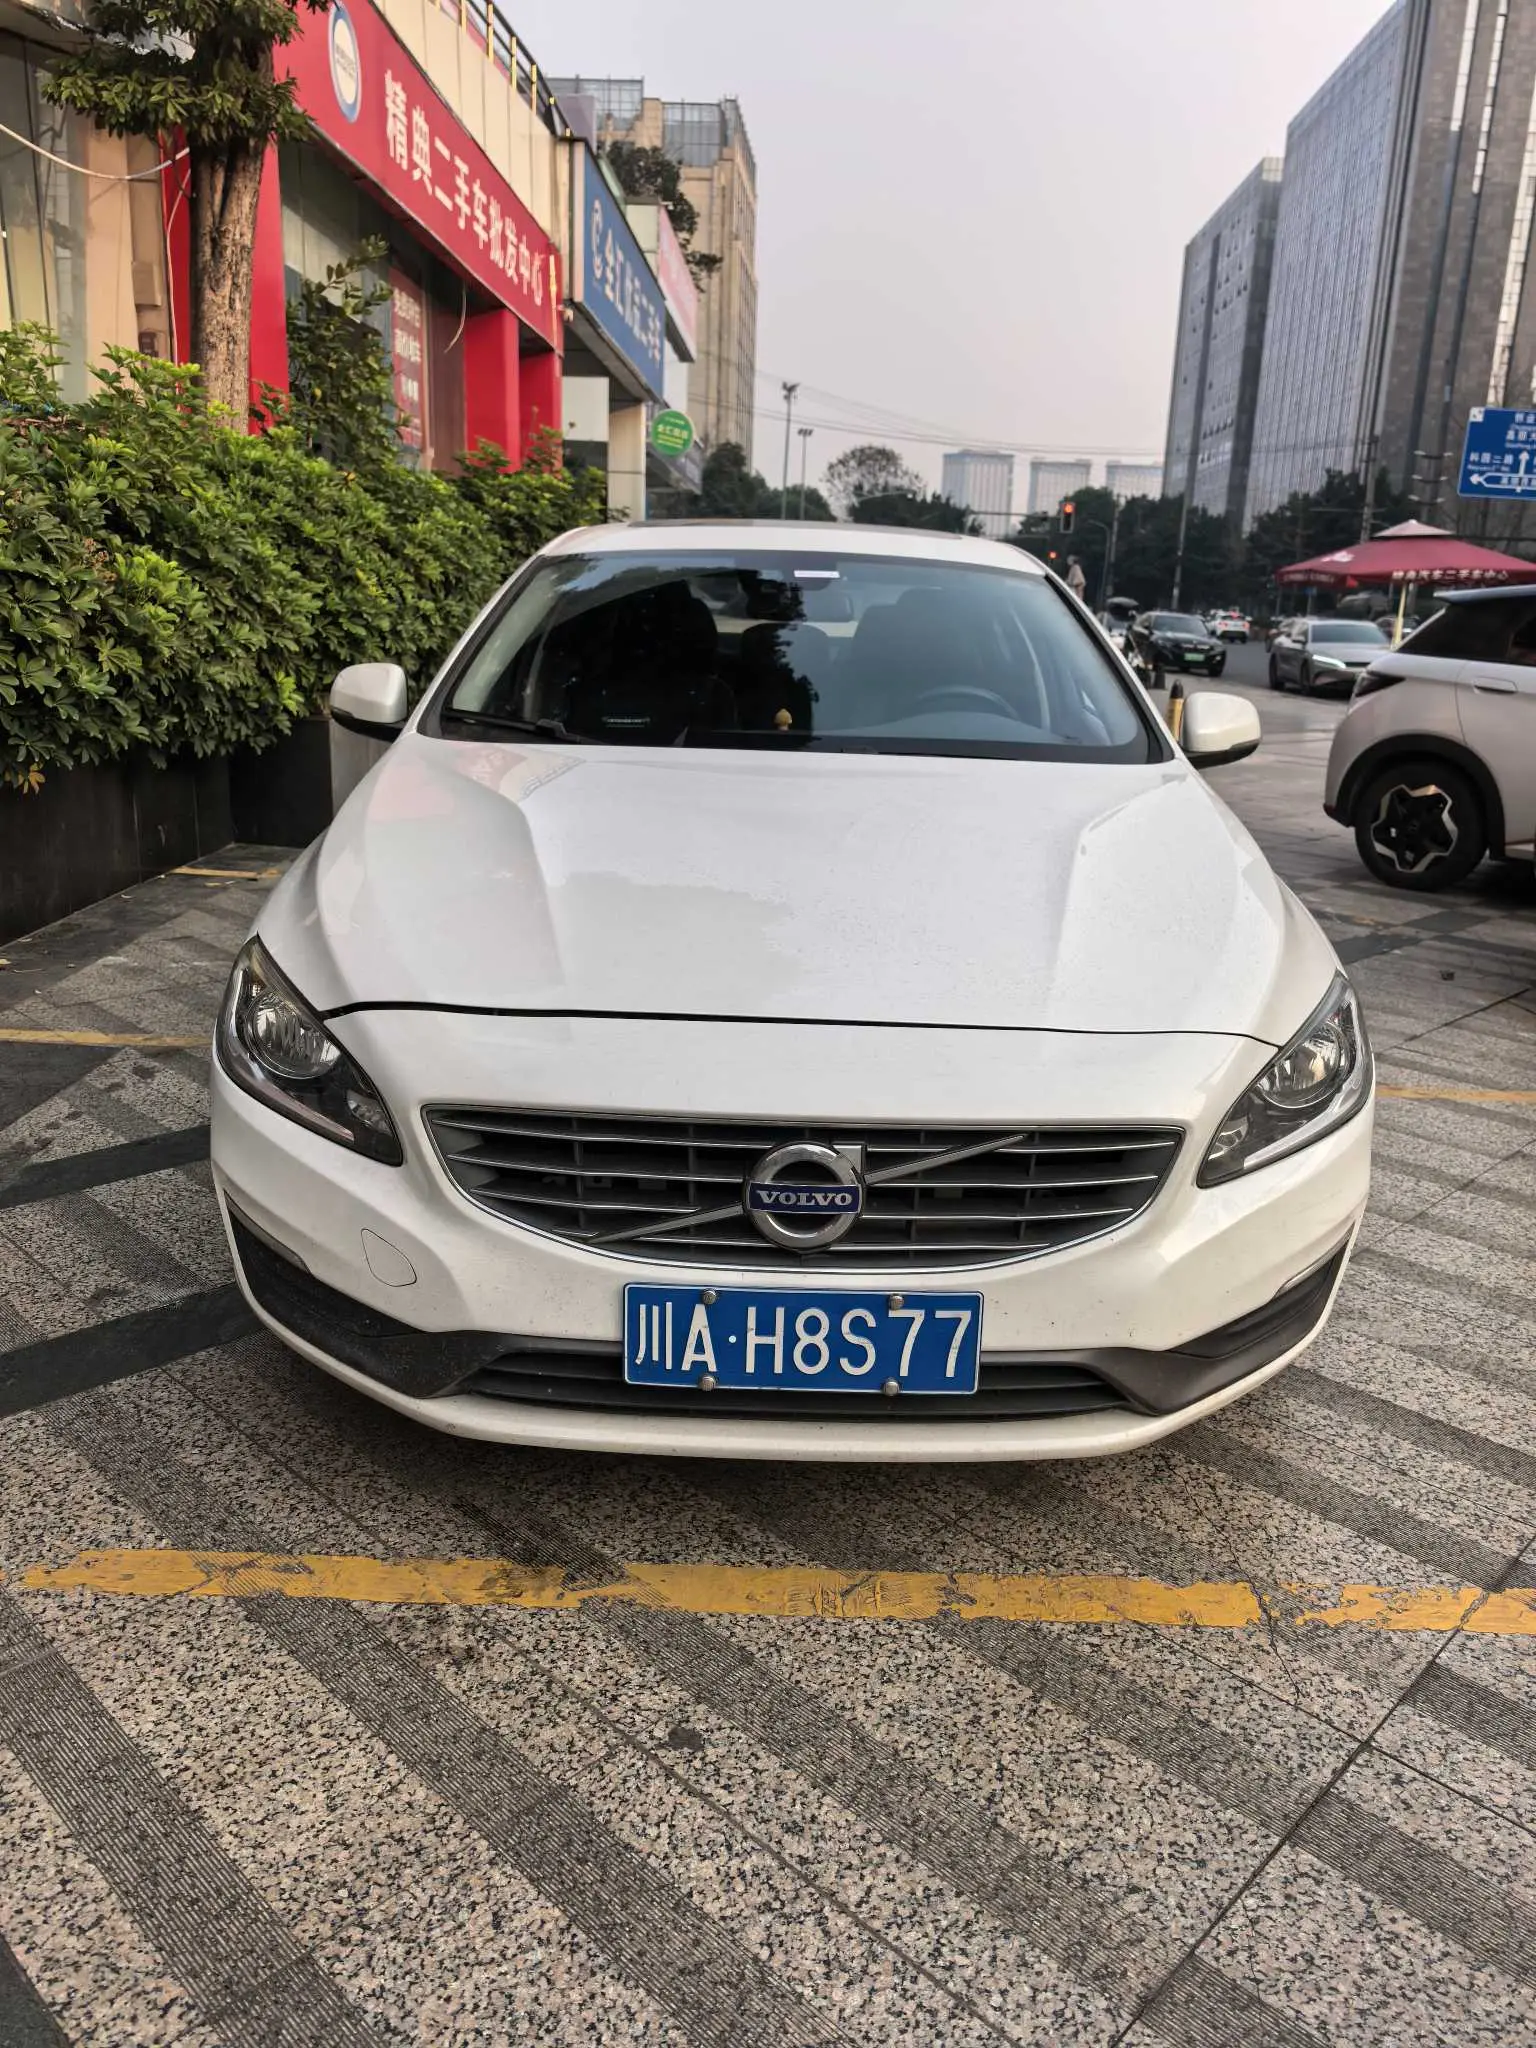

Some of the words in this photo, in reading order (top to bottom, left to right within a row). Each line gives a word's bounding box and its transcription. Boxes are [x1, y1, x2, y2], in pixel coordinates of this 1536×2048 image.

[384, 69, 543, 307] 精典二手车批发中心
[756, 1189, 853, 1208] VOLVO
[635, 1301, 972, 1378] 川A·H8S77
